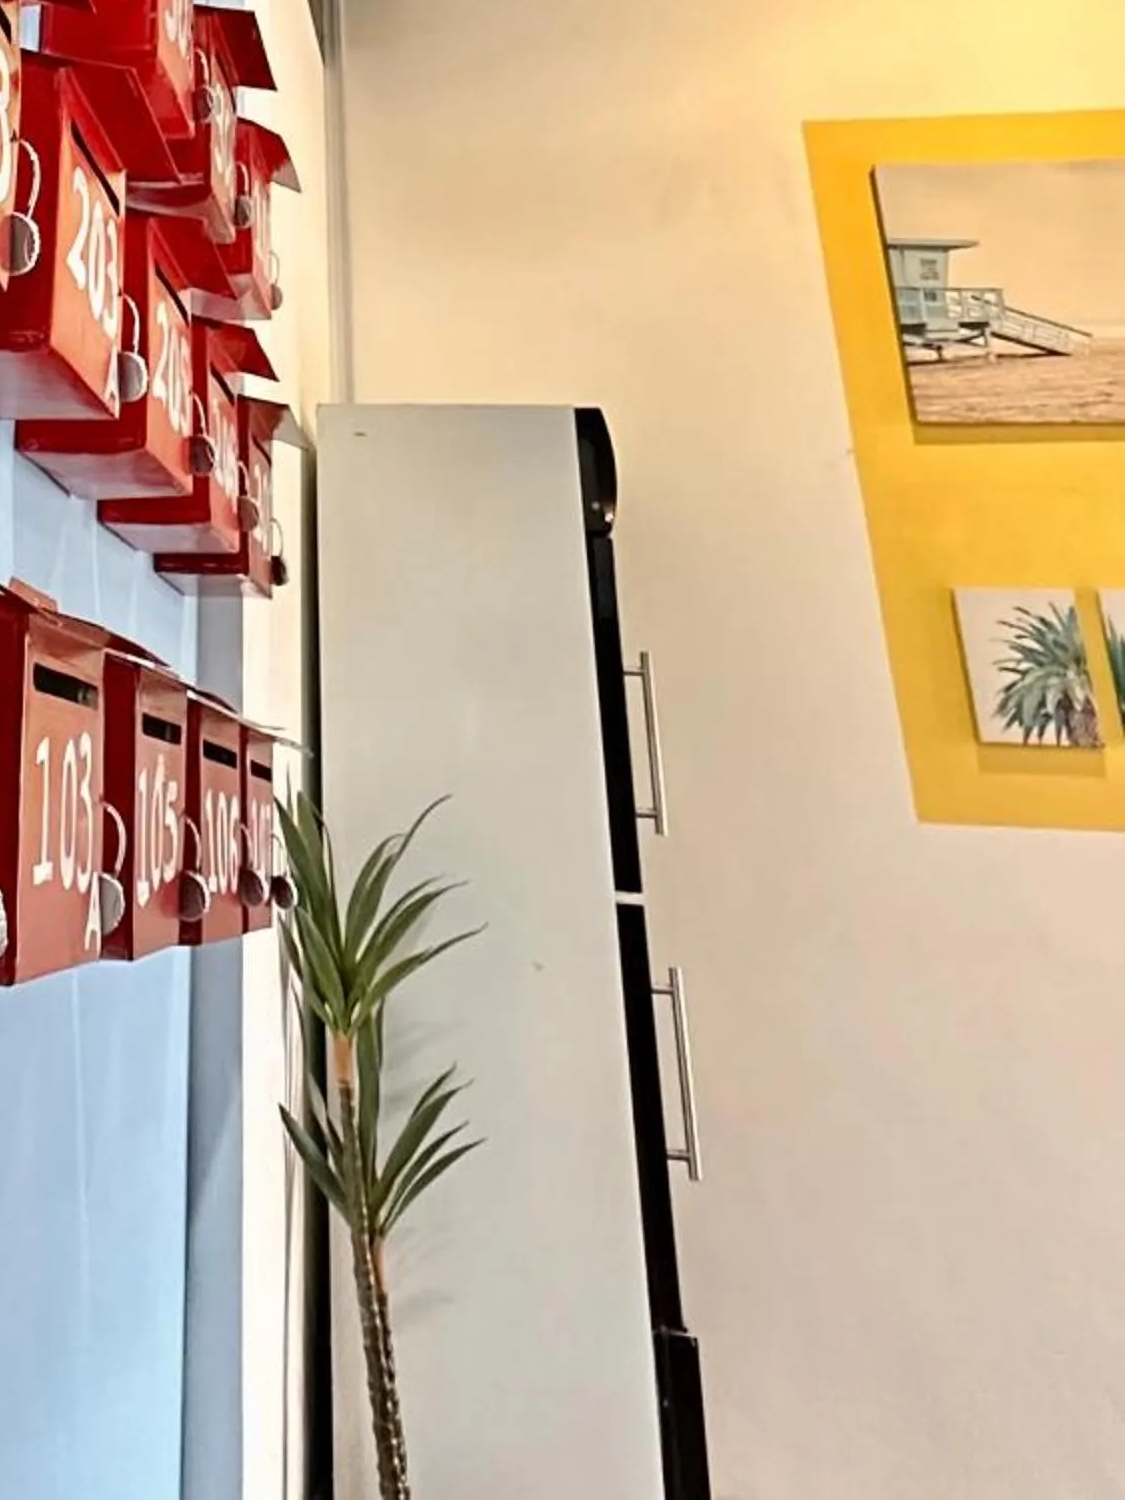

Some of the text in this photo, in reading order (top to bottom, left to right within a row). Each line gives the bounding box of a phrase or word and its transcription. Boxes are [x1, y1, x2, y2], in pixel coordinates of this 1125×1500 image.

[66, 166, 118, 340] 203
[33, 731, 94, 895] 103
[137, 753, 178, 908] 105
[84, 871, 102, 958] A
